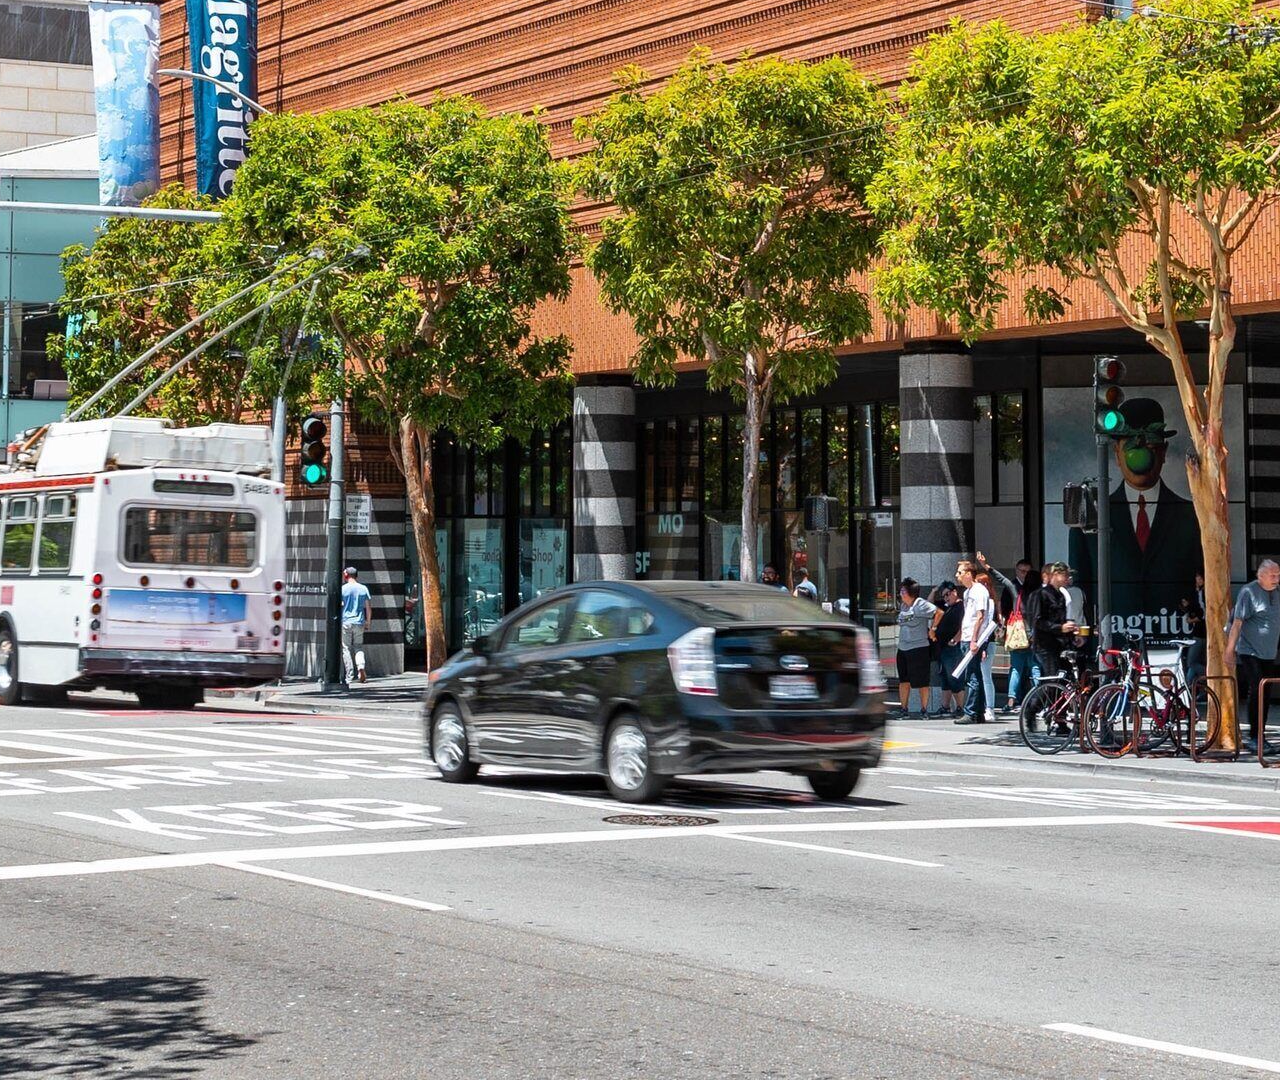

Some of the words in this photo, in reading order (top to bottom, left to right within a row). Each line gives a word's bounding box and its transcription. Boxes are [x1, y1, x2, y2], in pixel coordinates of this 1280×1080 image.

[658, 514, 684, 534] MO
[531, 550, 553, 563] Shop
[635, 551, 651, 574] SF
[1111, 608, 1195, 642] agritt
[53, 797, 468, 841] KEEP
